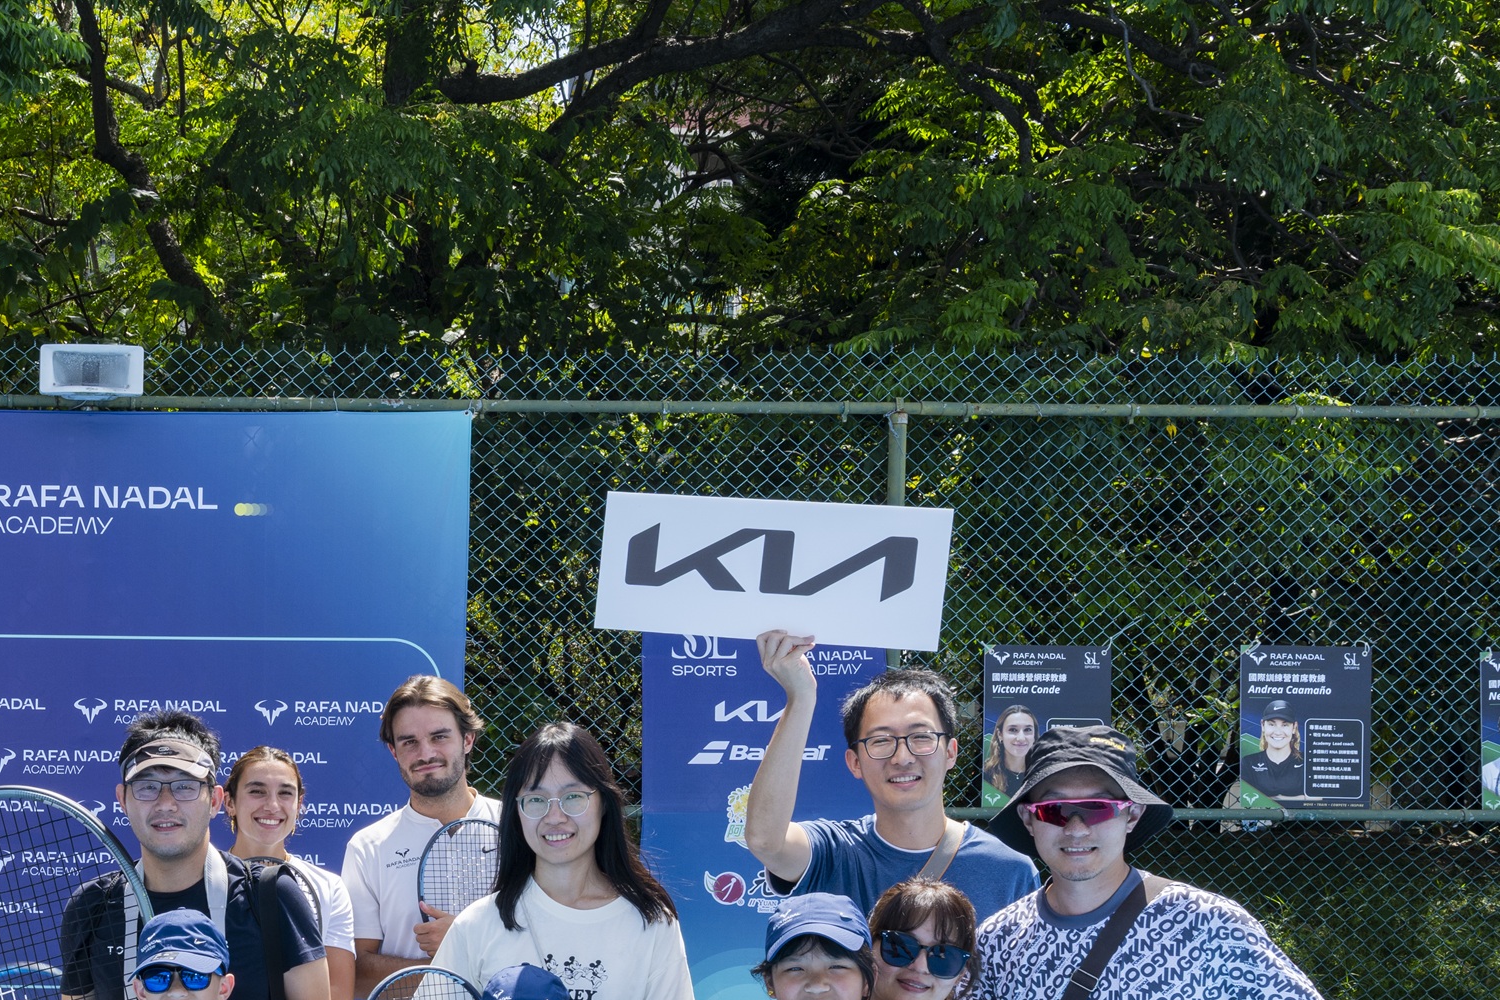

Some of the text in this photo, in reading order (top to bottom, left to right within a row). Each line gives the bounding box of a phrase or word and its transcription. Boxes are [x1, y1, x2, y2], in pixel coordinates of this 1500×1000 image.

[94, 486, 218, 510] NADAL
[625, 522, 919, 602] KIA
[818, 650, 873, 661] NADAL
[672, 665, 737, 677] SPORTS
[810, 663, 862, 676] ADEMY
[992, 685, 1060, 694] Victoria Conde
[1248, 685, 1332, 695] Andrea Caamaño
[114, 699, 226, 712] RAFA NADAL
[294, 701, 341, 713] RAFA
[294, 716, 355, 726] ACADEMY
[23, 750, 120, 762] RAFA NADA
[293, 752, 327, 764] DAL
[23, 765, 84, 775] ACADEMY
[295, 818, 354, 828] ACADEMY
[22, 851, 117, 864] RAFA NADA
[386, 860, 402, 868] RAFA
[22, 867, 83, 877] ACADEMY
